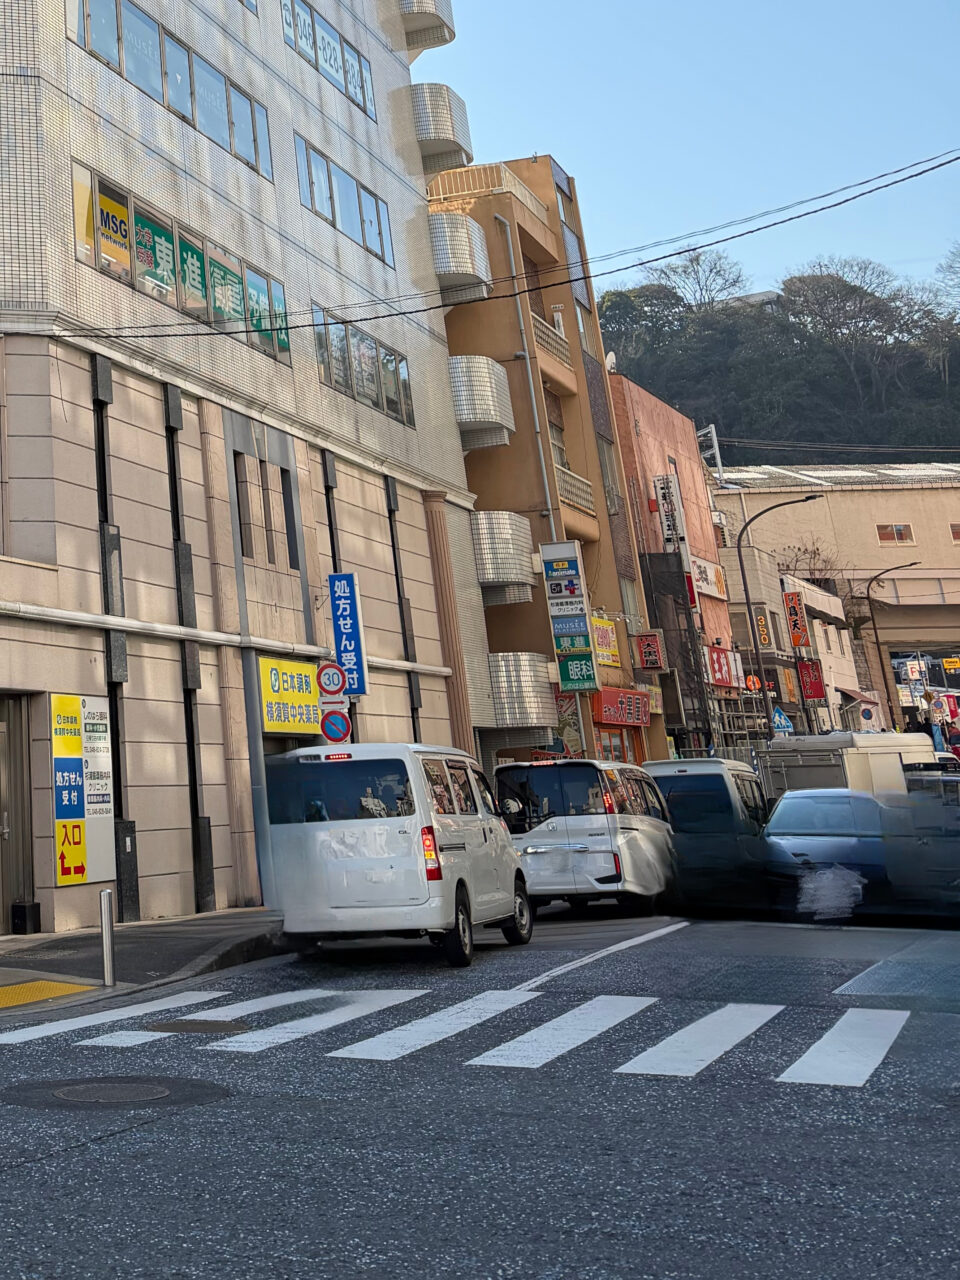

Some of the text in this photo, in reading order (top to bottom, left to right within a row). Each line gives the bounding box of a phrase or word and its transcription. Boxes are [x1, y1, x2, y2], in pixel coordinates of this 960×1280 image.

[100, 207, 128, 239] MSG
[100, 232, 128, 251] network
[334, 580, 359, 689] 処方せん受付
[757, 615, 769, 644] 350
[560, 636, 586, 649] 東進
[323, 672, 341, 687] 30
[568, 661, 595, 680] 眼科
[282, 671, 312, 695] 日本調剤
[266, 701, 320, 725] 横須賀中央薬局
[56, 771, 83, 786] 処方せん
[62, 790, 78, 805] 受付
[62, 824, 82, 846] 入口
